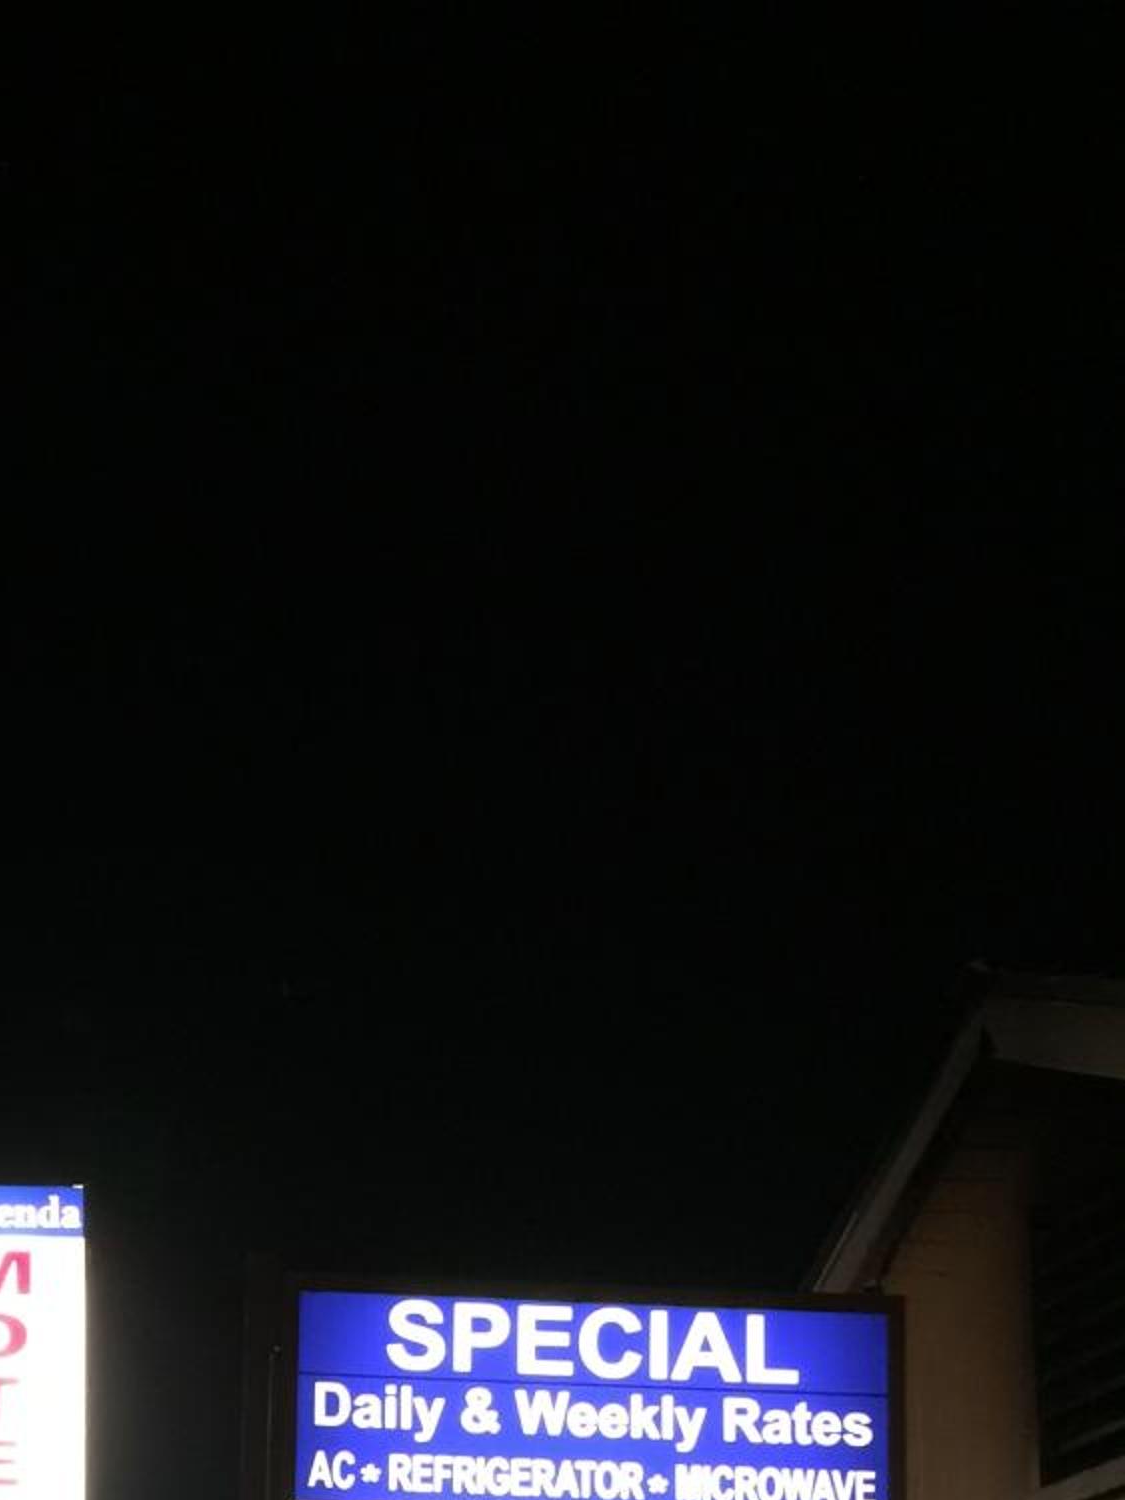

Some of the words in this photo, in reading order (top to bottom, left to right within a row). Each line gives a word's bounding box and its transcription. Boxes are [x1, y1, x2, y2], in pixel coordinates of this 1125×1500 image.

[386, 1298, 801, 1385] SPECIAL
[313, 1381, 445, 1442] Daily
[460, 1388, 501, 1435] &
[515, 1389, 708, 1452] Weekly
[722, 1396, 874, 1447] Rates
[307, 1450, 355, 1490] AC
[388, 1453, 645, 1500] REFRIGERATOR
